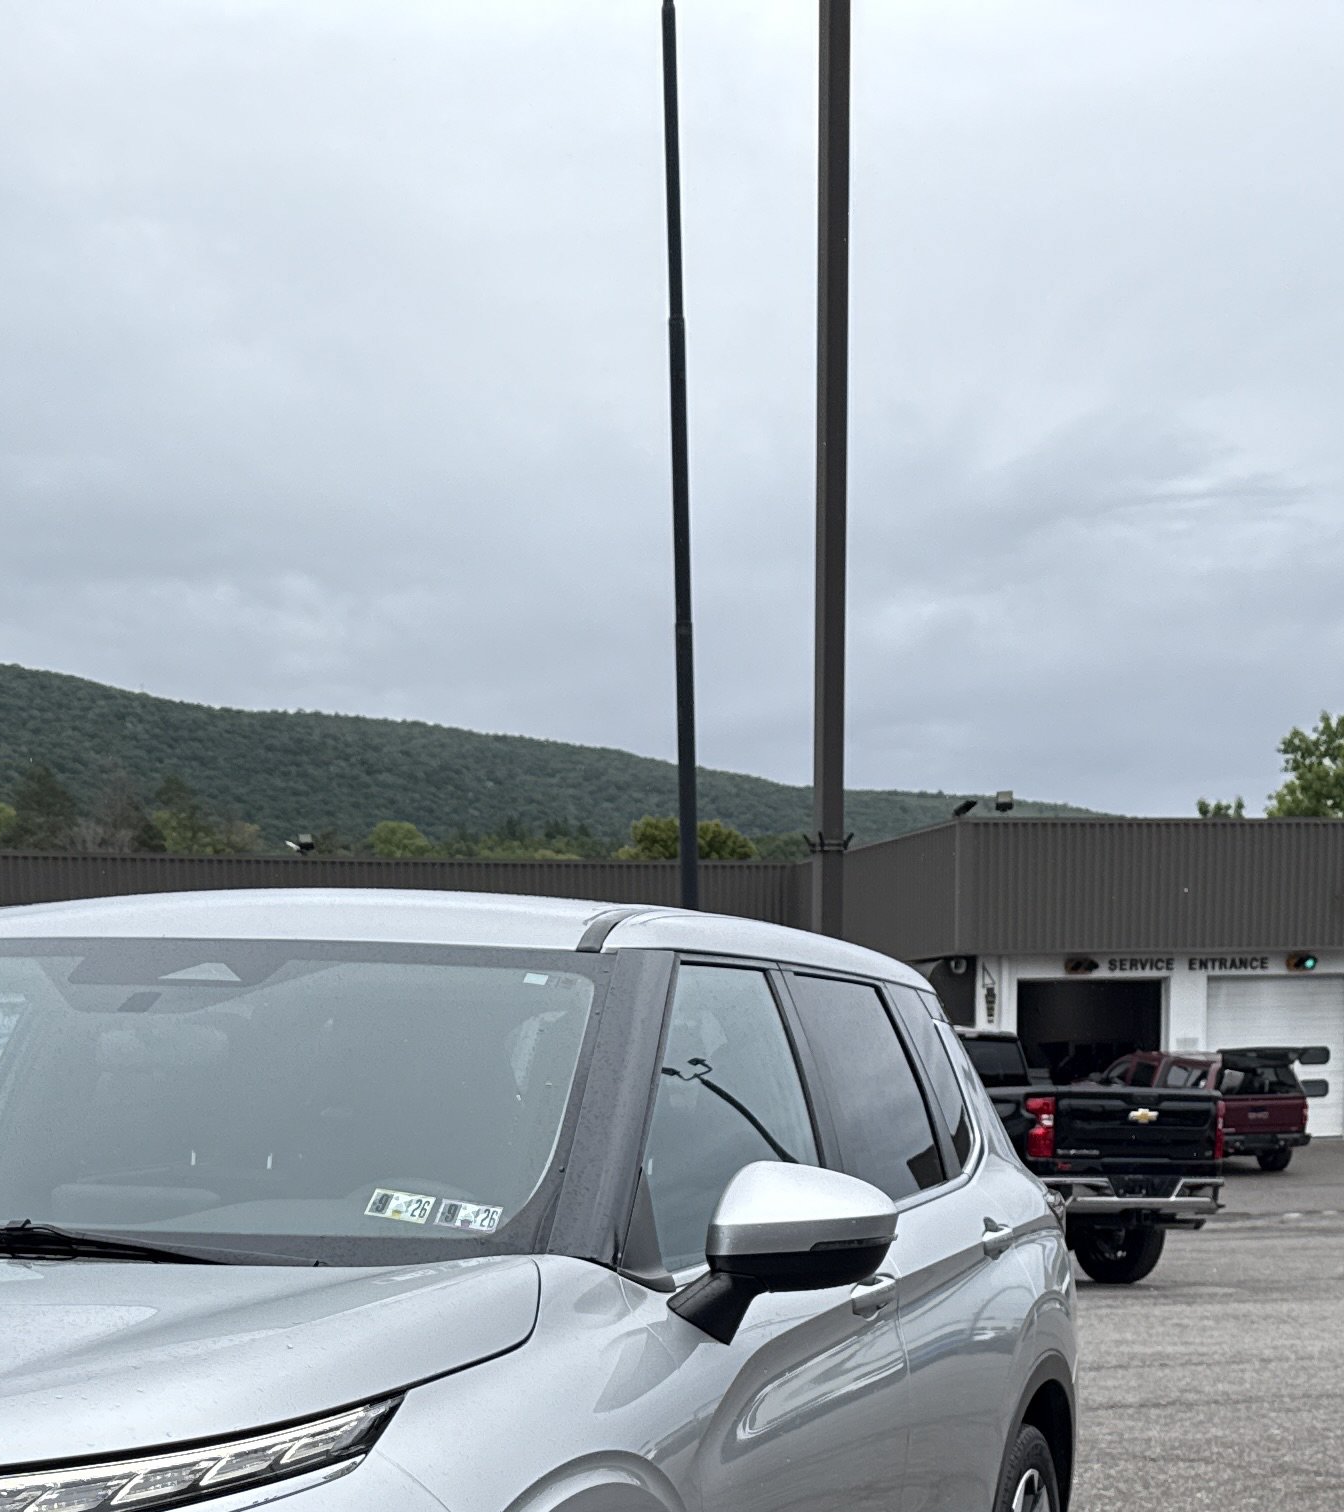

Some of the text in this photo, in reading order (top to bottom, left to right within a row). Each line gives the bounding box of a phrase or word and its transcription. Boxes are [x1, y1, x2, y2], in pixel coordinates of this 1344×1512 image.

[1108, 957, 1269, 972] SERVICE ENTRANCE
[410, 1198, 431, 1219] 26
[480, 1208, 498, 1229] 26
